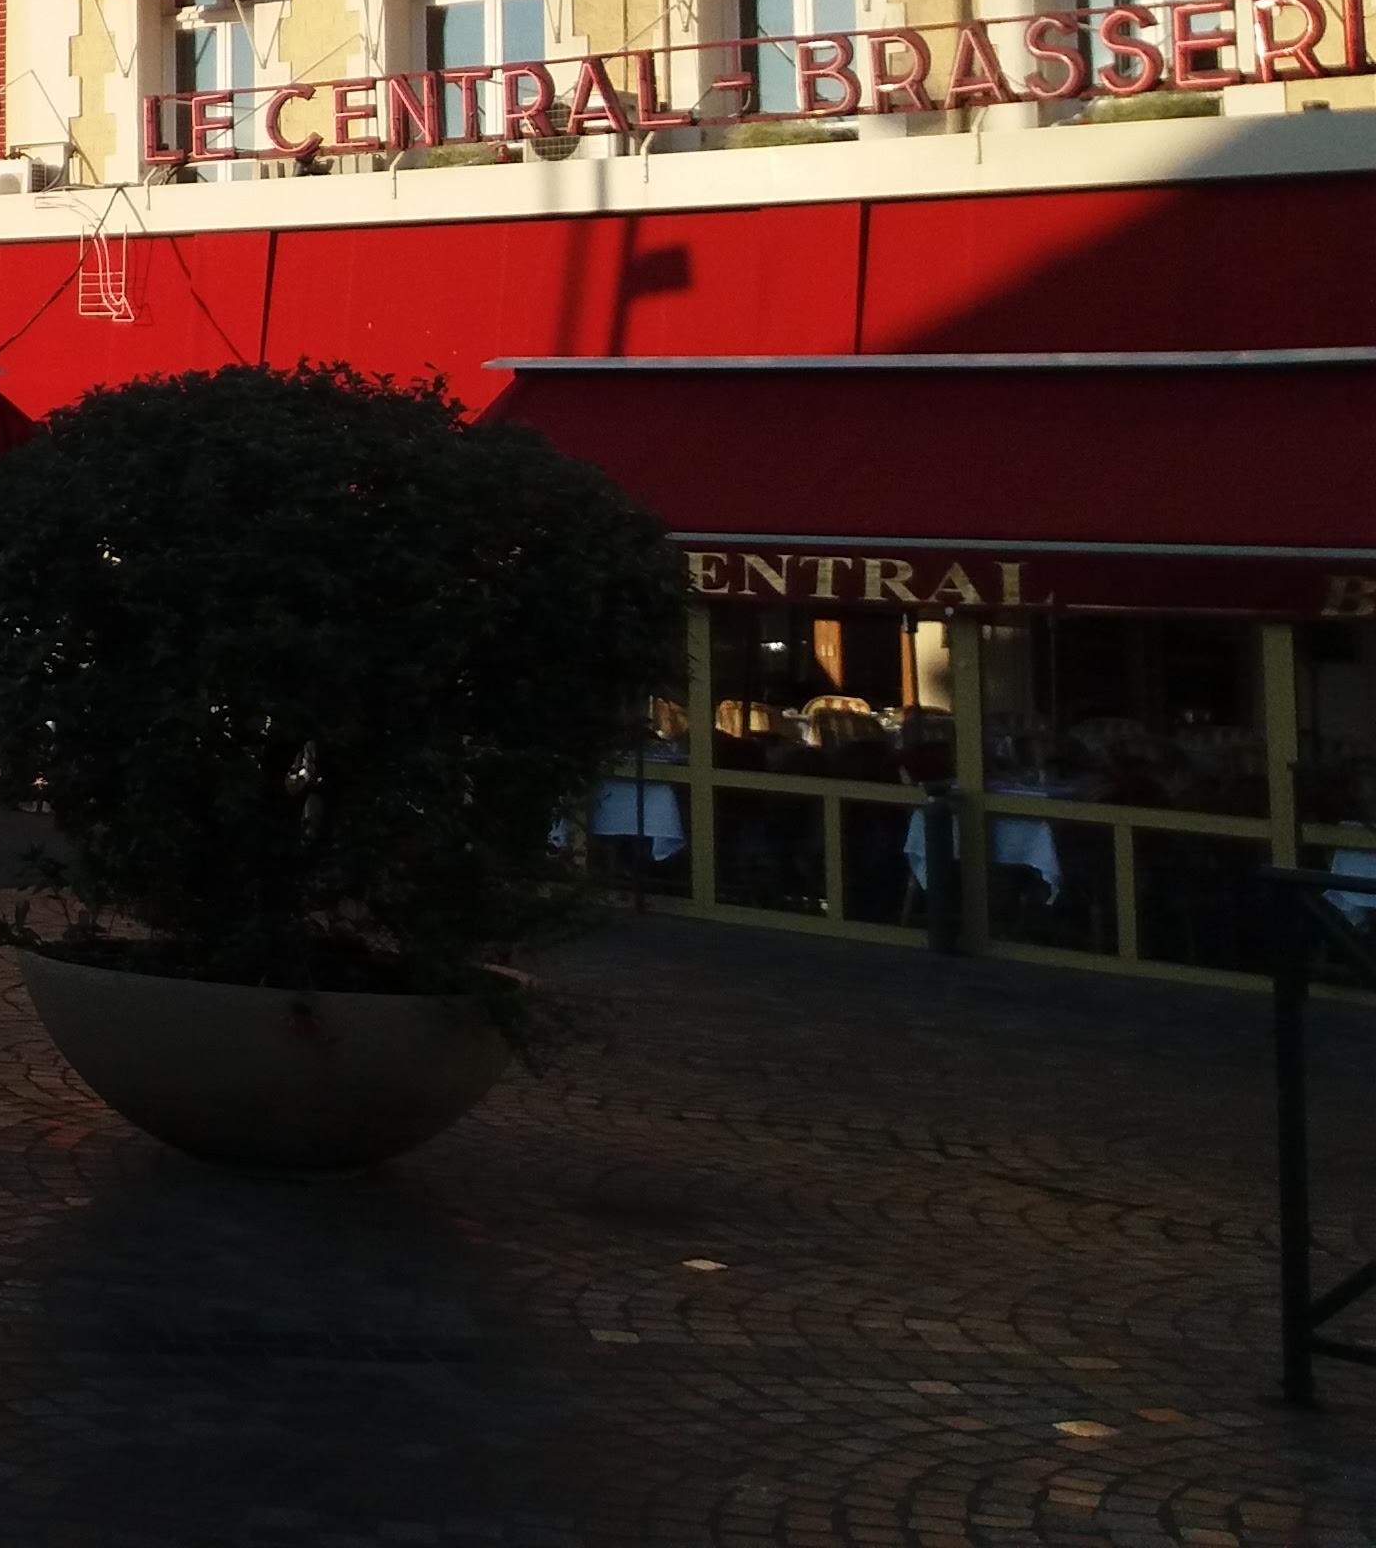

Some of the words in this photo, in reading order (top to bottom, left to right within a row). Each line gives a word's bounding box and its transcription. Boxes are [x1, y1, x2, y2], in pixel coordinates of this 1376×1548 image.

[144, 92, 234, 164] LE
[265, 51, 692, 153] CENTRAL
[685, 550, 1054, 606] ENTRAL
